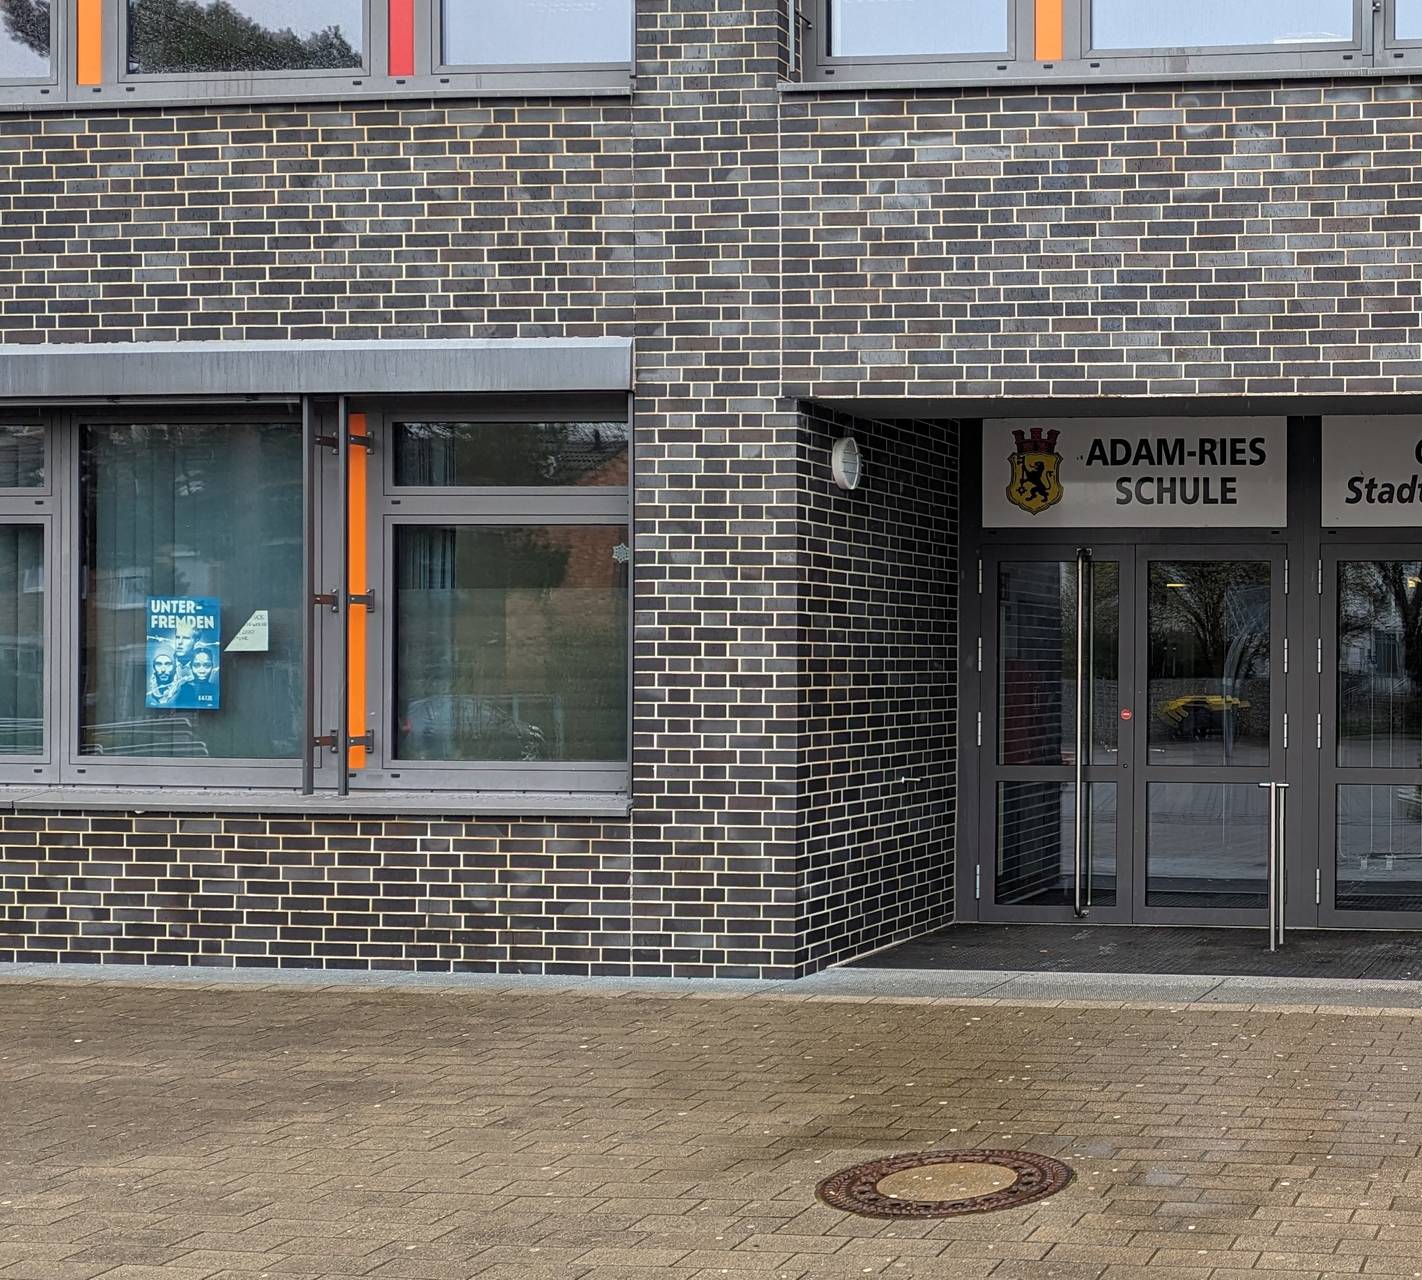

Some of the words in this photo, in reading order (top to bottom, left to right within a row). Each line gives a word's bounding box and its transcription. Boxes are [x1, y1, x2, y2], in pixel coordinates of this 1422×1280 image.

[1086, 437, 1266, 466] ADAM-RIES
[1116, 476, 1237, 505] SCHULE
[151, 599, 203, 614] UNTER-
[151, 615, 214, 629] FREMDEN
